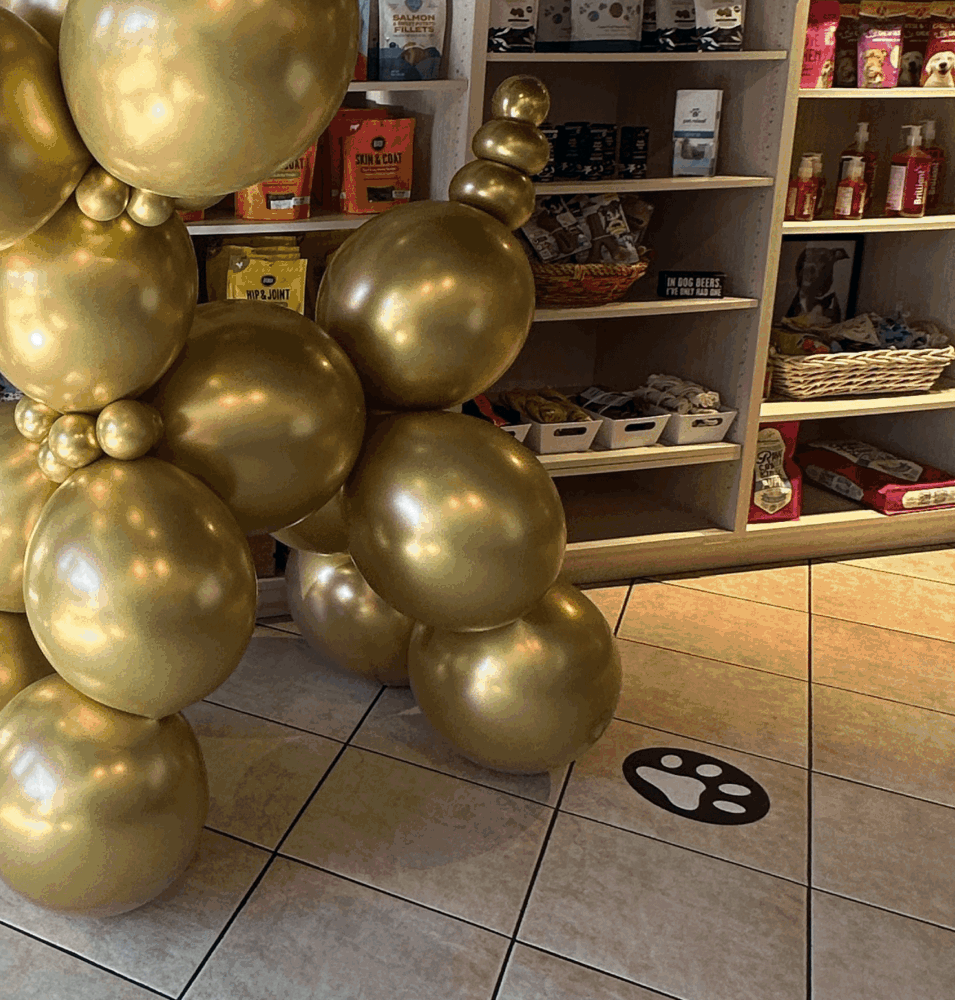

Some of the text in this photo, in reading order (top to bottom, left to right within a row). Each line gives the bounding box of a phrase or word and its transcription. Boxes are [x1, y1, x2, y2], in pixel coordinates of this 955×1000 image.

[355, 152, 402, 165] SKIN & COAT
[913, 165, 926, 205] Brilliant
[667, 277, 676, 287] IN
[678, 277, 694, 287] DOG
[246, 288, 290, 300] HIP & JOINT
[679, 287, 695, 296] ONLY
[696, 288, 708, 296] HAD
[709, 288, 722, 297] ONE
